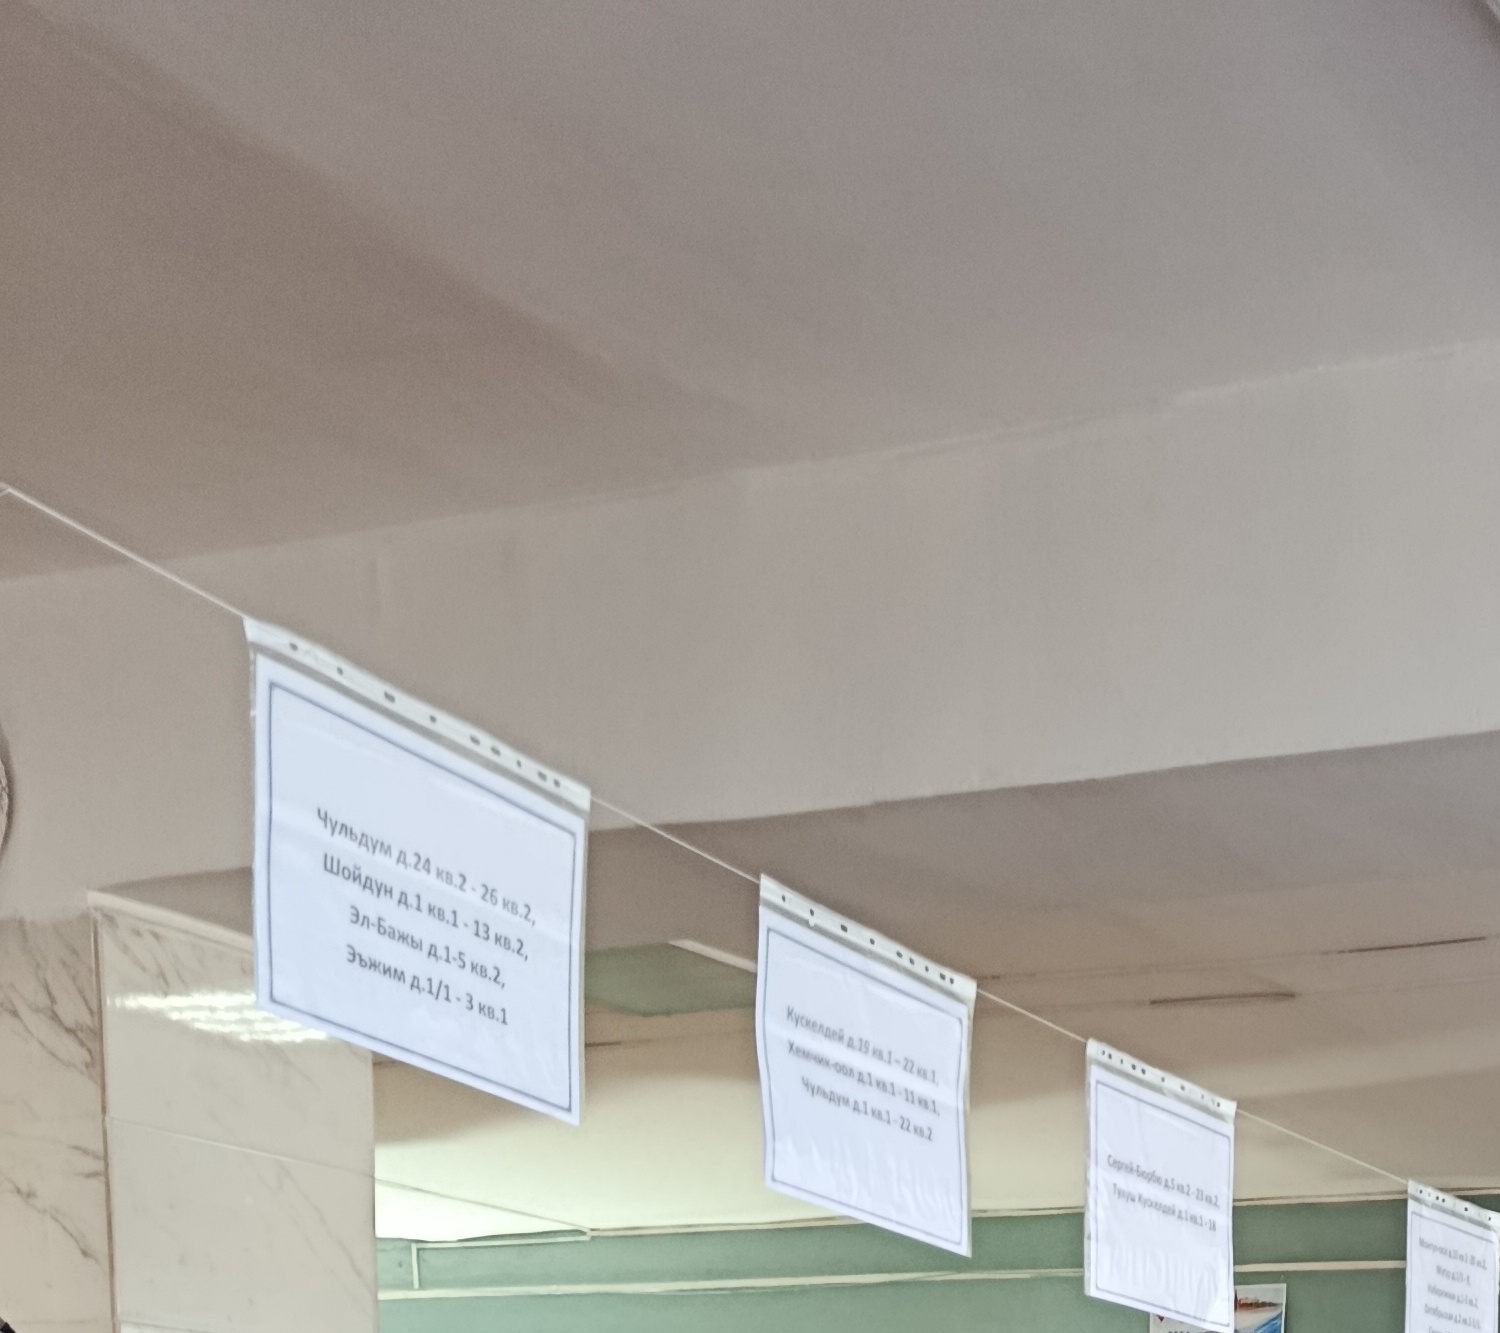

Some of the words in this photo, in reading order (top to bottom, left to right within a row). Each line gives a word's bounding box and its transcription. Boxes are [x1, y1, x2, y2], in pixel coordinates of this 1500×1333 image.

[316, 806, 393, 859] Чульдум
[395, 849, 432, 876] д.24
[435, 865, 468, 893] кв.2
[480, 883, 498, 907] 26
[502, 896, 537, 928] кв.2,
[323, 852, 394, 900] Шойдун
[397, 890, 423, 914] д.1
[428, 902, 459, 928] кв.1
[473, 919, 491, 942] 13
[494, 931, 529, 962] кв.2,
[346, 943, 407, 985] Эъжим
[409, 973, 452, 1004] д.1/1
[465, 992, 474, 1011] 3
[478, 1000, 509, 1026] кв.1
[349, 904, 423, 951] Эл-Бажы
[427, 942, 466, 971] д.1-5
[470, 958, 506, 990] кв.2,
[903, 1057, 915, 1075] 22
